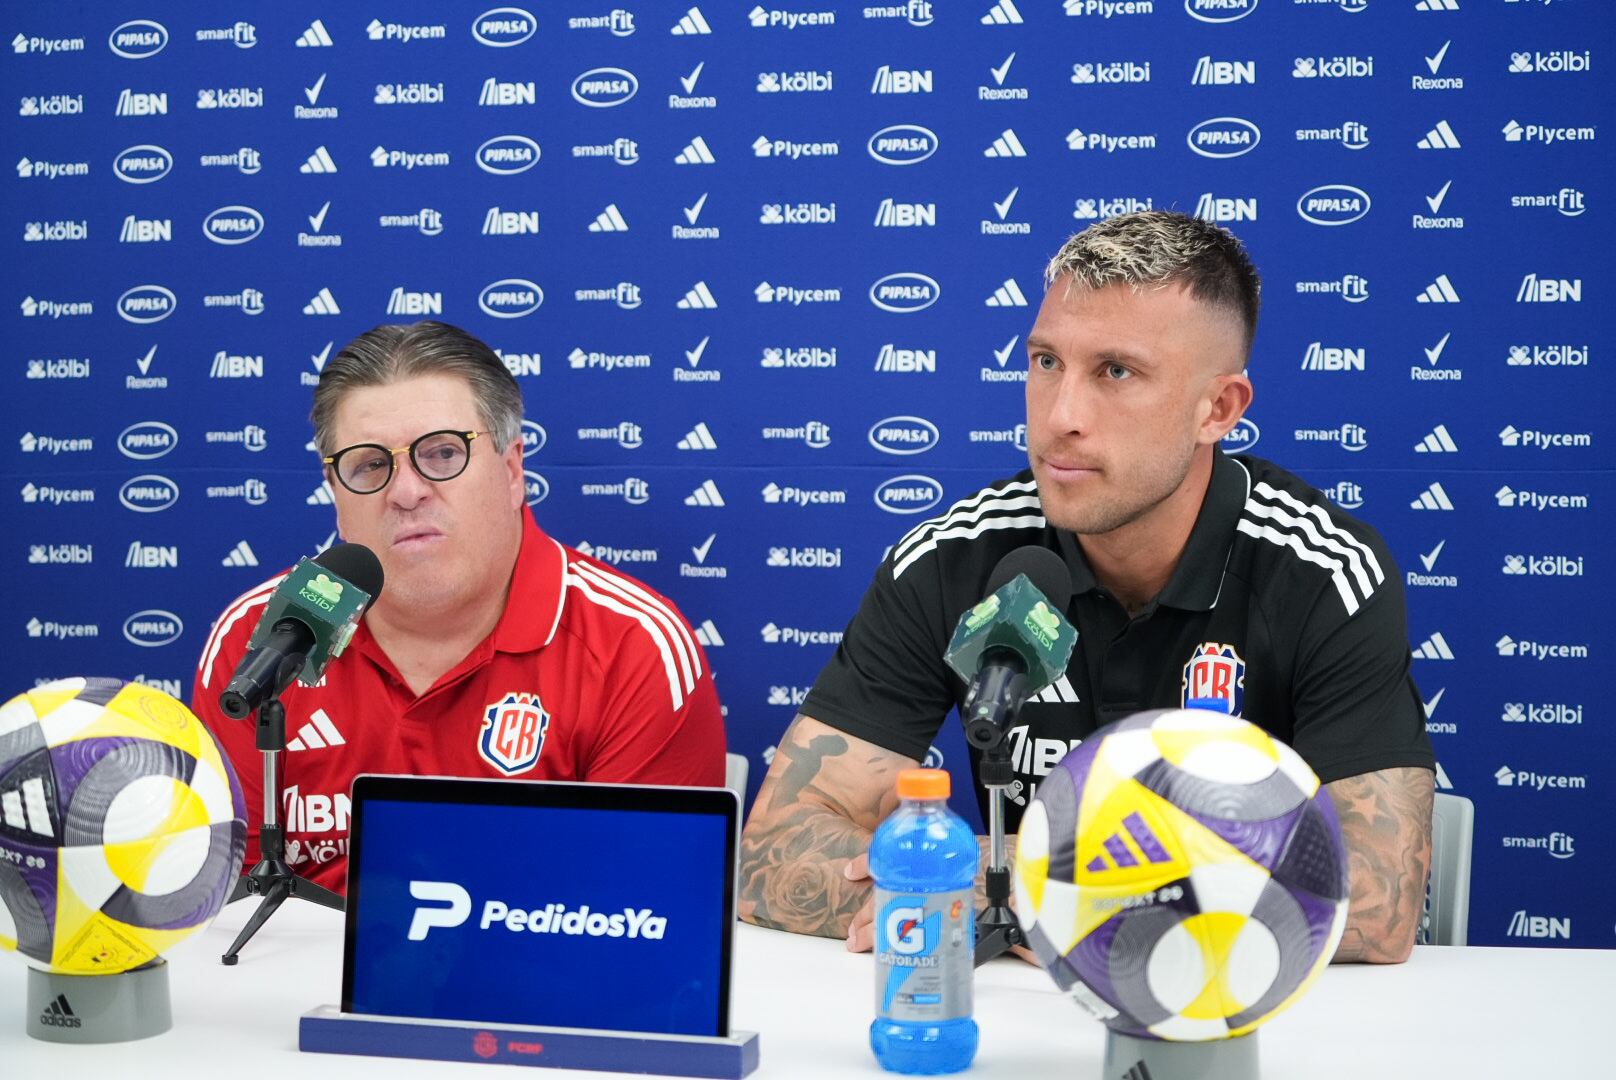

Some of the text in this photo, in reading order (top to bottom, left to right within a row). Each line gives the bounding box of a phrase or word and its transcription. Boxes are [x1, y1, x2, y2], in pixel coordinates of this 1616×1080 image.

[1086, 0, 1153, 18] Plycem
[480, 19, 529, 35] PIPASA
[770, 11, 834, 29] Plycem
[116, 30, 160, 46] PIPASA
[385, 24, 445, 42] Plycem
[31, 38, 84, 55] Plycem
[1319, 57, 1372, 77] kölbi
[1536, 51, 1589, 71] kölbi
[781, 71, 832, 91] kölbi
[1097, 62, 1150, 83] kölbi
[580, 78, 628, 94] PIPASA
[1413, 76, 1463, 89] Rexona
[217, 88, 263, 107] kölbi
[395, 83, 443, 103] kölbi
[669, 95, 716, 108] Rexona
[979, 86, 1028, 100] Rexona
[40, 95, 83, 114] kölbi
[295, 105, 338, 119] Rexona
[876, 136, 928, 151] PIPASA
[1089, 134, 1155, 152] Plycem
[1196, 128, 1250, 144] PIPASA
[1526, 125, 1594, 144] Plycem
[483, 146, 531, 161] PIPASA
[774, 141, 838, 159] Plycem
[121, 155, 164, 171] PIPASA
[389, 151, 449, 169] Plycem
[35, 162, 88, 179] Plycem
[783, 203, 835, 223] kölbi
[1306, 198, 1360, 212] PIPASA
[43, 221, 87, 240] kölbi
[211, 216, 255, 231] PIPASA
[981, 221, 1030, 234] Rexona
[1413, 215, 1463, 228] Rexona
[298, 231, 341, 246] Rexona
[672, 225, 719, 239] Rexona
[486, 289, 536, 305] PIPASA
[775, 287, 840, 305] Plycem
[878, 285, 930, 300] PIPASA
[39, 301, 92, 318] Plycem
[124, 295, 167, 311] PIPASA
[587, 353, 650, 371] Plycem
[784, 348, 836, 367] kölbi
[1534, 346, 1587, 365] kölbi
[47, 359, 89, 378] kölbi
[674, 368, 720, 381] Rexona
[1411, 367, 1461, 380] Rexona
[126, 432, 169, 446] PIPASA
[876, 427, 930, 443] PIPASA
[1523, 431, 1590, 449] Plycem
[39, 437, 92, 454] Plycem
[40, 487, 94, 505] Plycem
[127, 487, 171, 500] PIPASA
[782, 487, 845, 506] Plycem
[883, 485, 933, 501] PIPASA
[1519, 492, 1587, 510] Plycem
[49, 545, 92, 563] kölbi
[596, 547, 657, 565] Plycem
[791, 548, 841, 567] kölbi
[680, 564, 726, 577] Rexona
[1529, 556, 1583, 576] kölbi
[1407, 572, 1457, 586] Rexona
[299, 587, 335, 612] kölbi
[45, 622, 98, 639] Plycem
[131, 622, 175, 635] PIPASA
[782, 628, 843, 646] Plycem
[1520, 641, 1587, 660] Plycem
[1529, 704, 1582, 723] kölbi
[496, 709, 538, 760] CR
[1425, 722, 1457, 734] xona
[1518, 772, 1585, 790] Plycem
[304, 838, 350, 864] köl
[480, 900, 667, 940] PedidosYa
[40, 1013, 82, 1028] adidas
